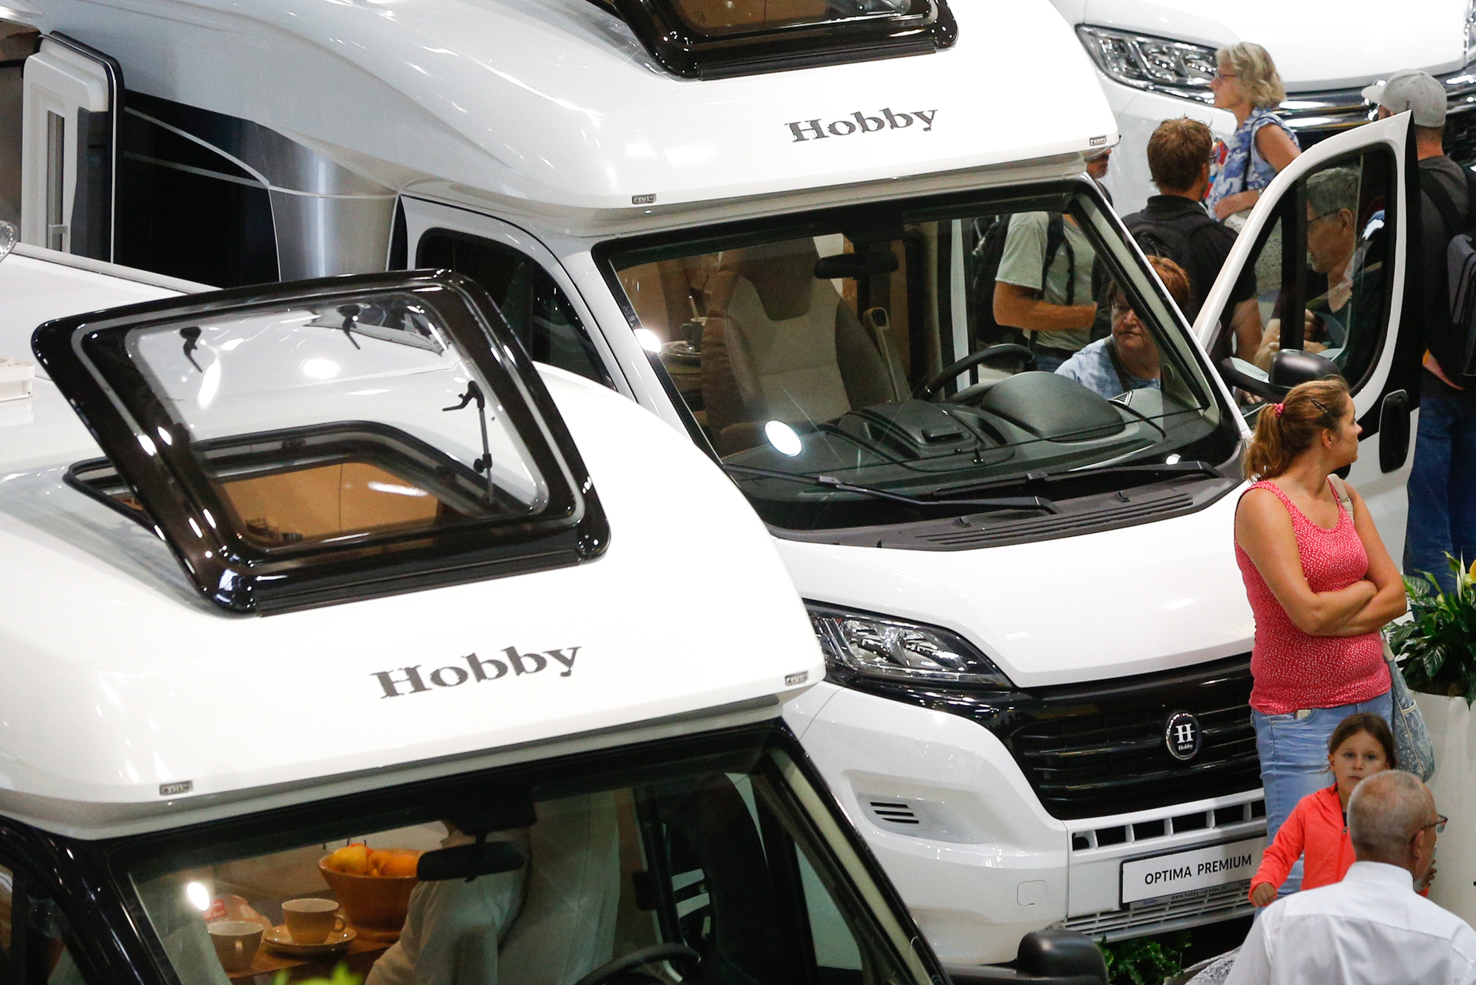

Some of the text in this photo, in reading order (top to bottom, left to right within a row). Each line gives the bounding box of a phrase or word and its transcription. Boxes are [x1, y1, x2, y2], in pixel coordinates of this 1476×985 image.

[784, 107, 939, 143] Hobby
[370, 645, 583, 700] Hobby
[1144, 854, 1253, 885] OPTIMA PREMIUM
